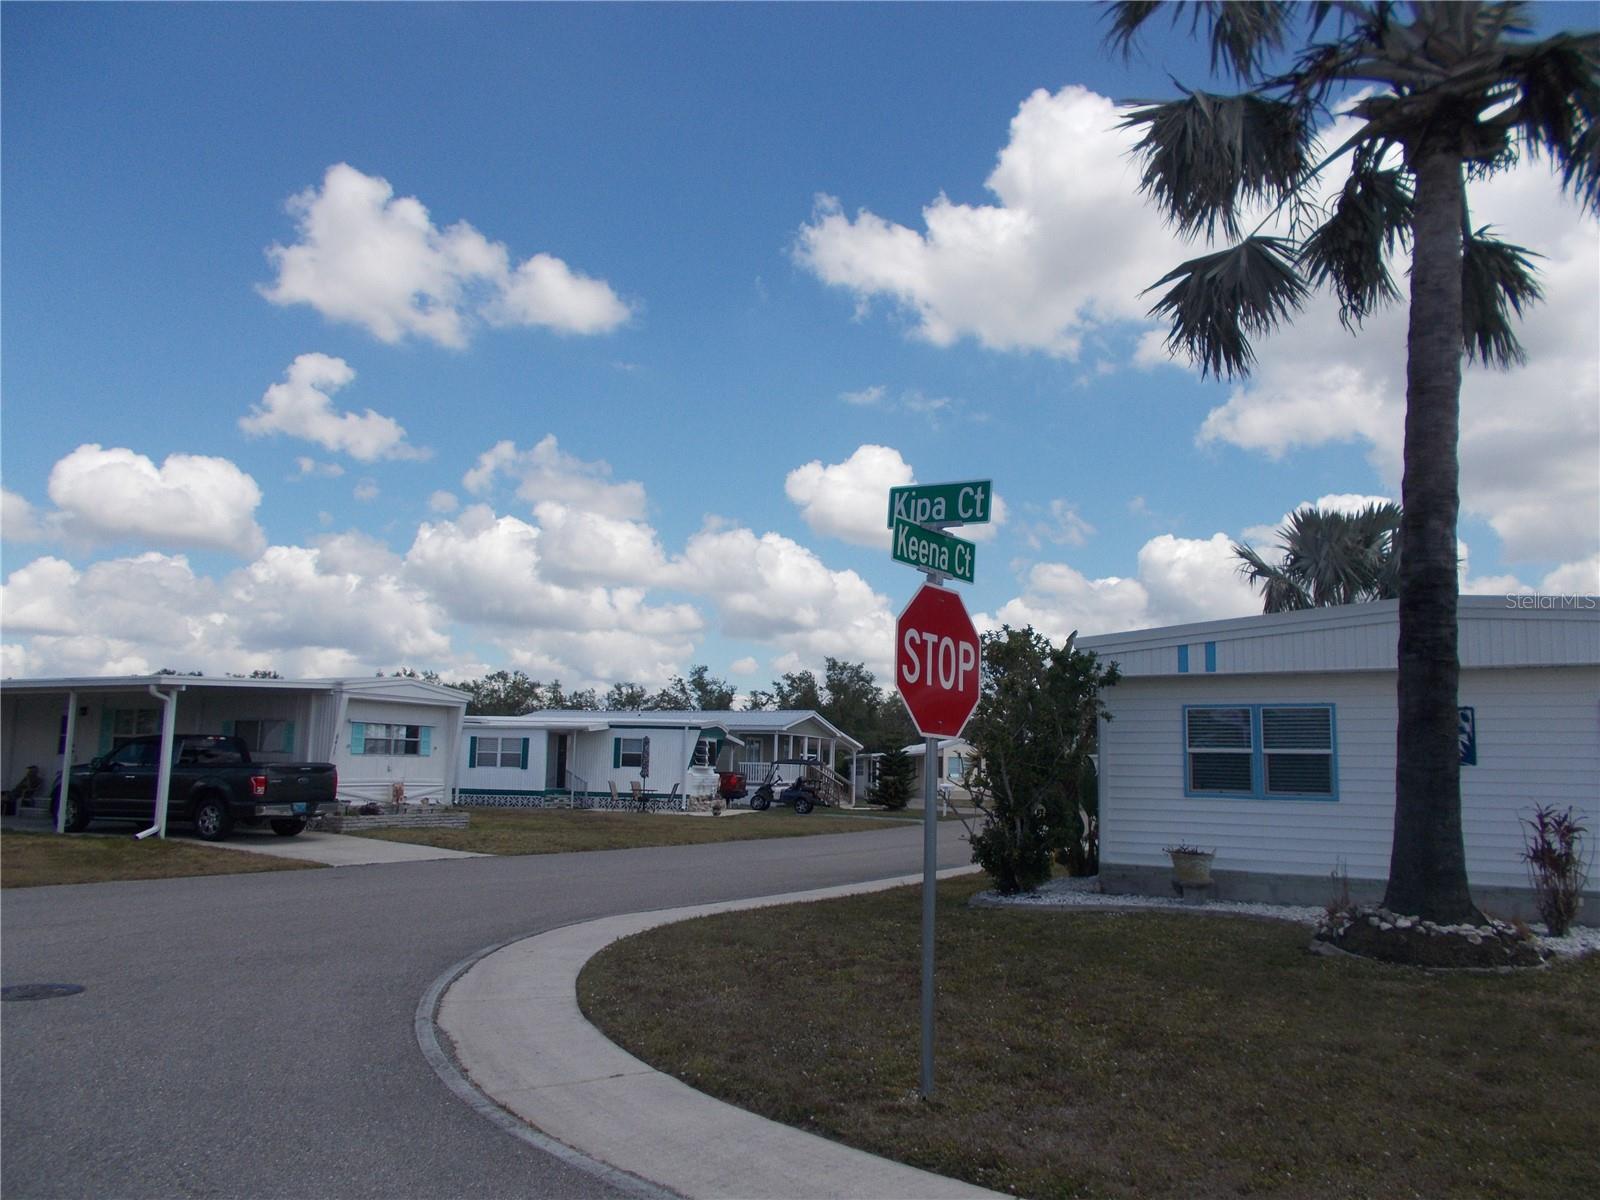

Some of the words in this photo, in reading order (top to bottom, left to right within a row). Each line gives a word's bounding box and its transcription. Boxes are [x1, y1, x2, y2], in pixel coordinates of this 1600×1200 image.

[894, 490, 946, 524] Kipa
[958, 486, 985, 518] Ct
[897, 523, 949, 571] Keena
[954, 544, 972, 578] Ct
[902, 628, 976, 692] STOP
